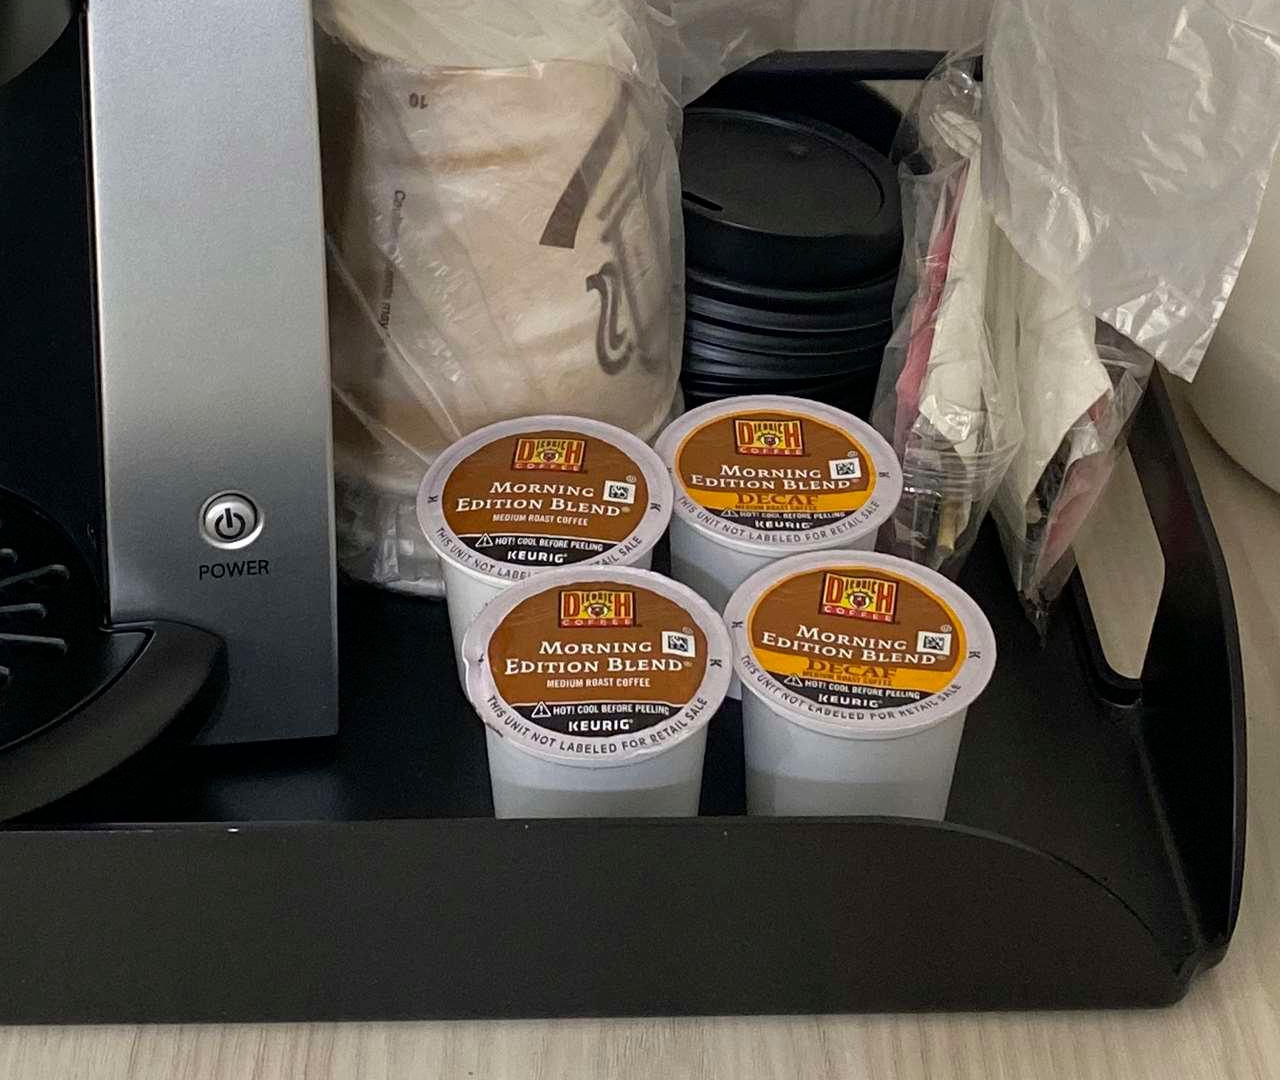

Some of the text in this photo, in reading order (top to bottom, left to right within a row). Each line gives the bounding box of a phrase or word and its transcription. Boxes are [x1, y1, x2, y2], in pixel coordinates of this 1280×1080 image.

[720, 464, 821, 479] MORNING
[691, 474, 850, 490] EDITION BLEND
[489, 482, 595, 498] MORNING
[427, 494, 438, 503] K
[737, 492, 818, 505] DECAF
[455, 498, 621, 517] EDITION BLEND
[650, 502, 662, 513] K
[492, 513, 588, 526] MEDIUM ROAST COFFEE
[678, 495, 880, 542] THIS UNIT NOT LABELED FOR RETAIL SALE
[754, 520, 810, 529] KEURIG
[436, 527, 453, 547] THIS
[450, 545, 472, 562] UNIT
[474, 560, 495, 572] NOT
[618, 536, 642, 557] SALE
[495, 537, 603, 551] HOT! COOL BEFORE PEELING
[507, 551, 564, 563] KEURIG
[199, 560, 269, 580] POWER
[824, 606, 892, 622] COFFEE
[796, 624, 908, 650] MORNING
[539, 641, 653, 655] MORNING
[761, 631, 936, 665] EDITION BLEND
[504, 658, 599, 675] EDITION
[607, 657, 683, 672] BLEND
[709, 658, 722, 668] K
[807, 660, 897, 679] DECAF
[546, 678, 651, 688] MEDIUM ROAST COFFEE
[741, 655, 961, 720] THIS UNIT NOT LABELED FOR RETAIL SALE
[805, 680, 920, 700] HOT! COOL BEFORE PEELING
[818, 694, 880, 708] KEURIG
[553, 704, 670, 716] HOT! COOL BEFORE PEELING
[488, 695, 708, 754] THIS UNIT NOT LABELED FOR RETAIL SALE
[568, 719, 630, 732] KEURIG
